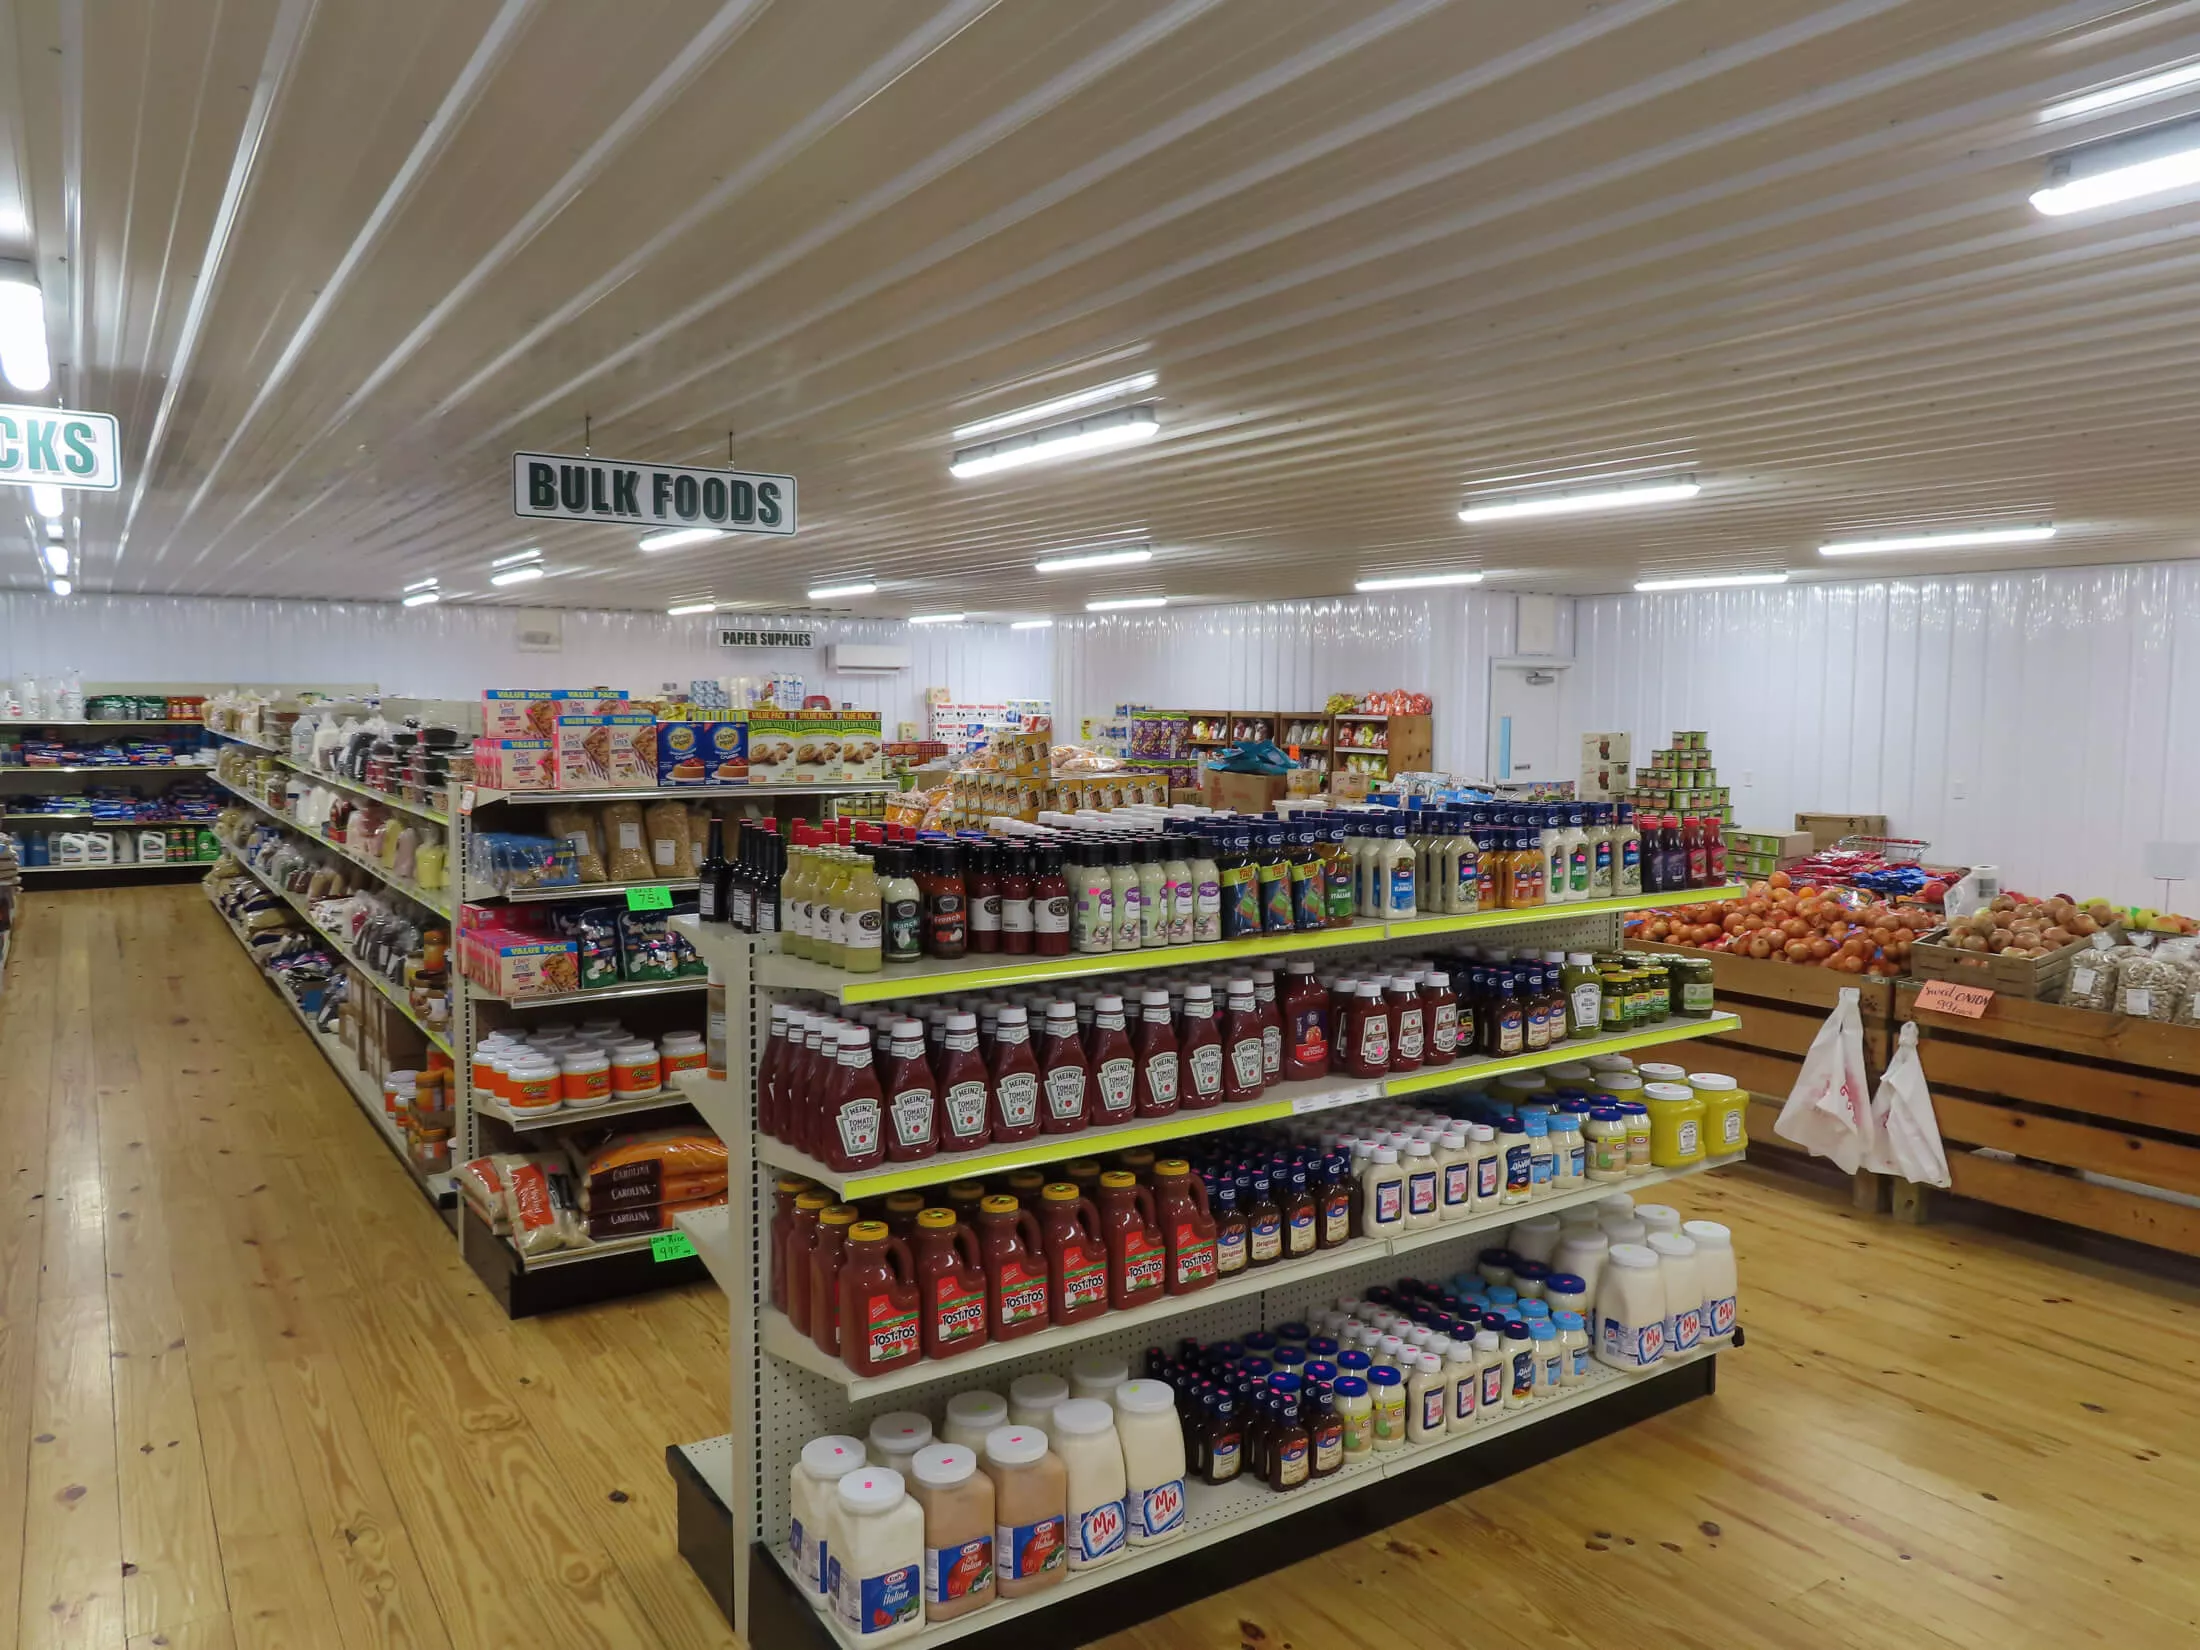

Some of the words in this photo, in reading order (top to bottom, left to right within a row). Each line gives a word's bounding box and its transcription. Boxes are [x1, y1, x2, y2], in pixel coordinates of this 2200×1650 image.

[529, 462, 640, 516] BULK
[653, 473, 781, 526] FOODS
[722, 631, 757, 645] PAPER
[760, 631, 811, 647] SUPPLIES
[497, 691, 525, 699] VALUE
[529, 691, 552, 699] PACK
[567, 691, 595, 699] VALUE
[511, 740, 540, 749] VALUE
[934, 914, 960, 924] French
[510, 946, 540, 955] VALUE
[543, 944, 567, 953] PACK
[1240, 1043, 1258, 1052] HEINZ
[1200, 1050, 1217, 1059] HEINZ
[1156, 1058, 1174, 1067] HEINZ
[1108, 1063, 1129, 1073] HEINZ
[1056, 1072, 1078, 1081] HEINZ
[1108, 1075, 1129, 1084] TOMATO
[1008, 1079, 1030, 1089] HEINZ
[1055, 1084, 1080, 1092] TOMATO
[958, 1087, 979, 1097] HEINZ
[1008, 1090, 1032, 1099] TOMATO
[904, 1095, 926, 1106] HEINZ
[957, 1099, 981, 1108] TOMATO
[849, 1105, 872, 1115] HEINZ
[903, 1107, 928, 1117] TOMATO
[848, 1116, 874, 1127] TOMATO
[612, 1164, 650, 1181] CAROLINA
[611, 1183, 651, 1200] CAROLINA
[610, 1210, 650, 1224] CAROLINA
[1255, 1239, 1279, 1248] Original
[1155, 1489, 1177, 1513] MW
[1093, 1511, 1116, 1535] MW
[961, 1559, 982, 1573] Italian
[883, 1590, 909, 1606] Italian
